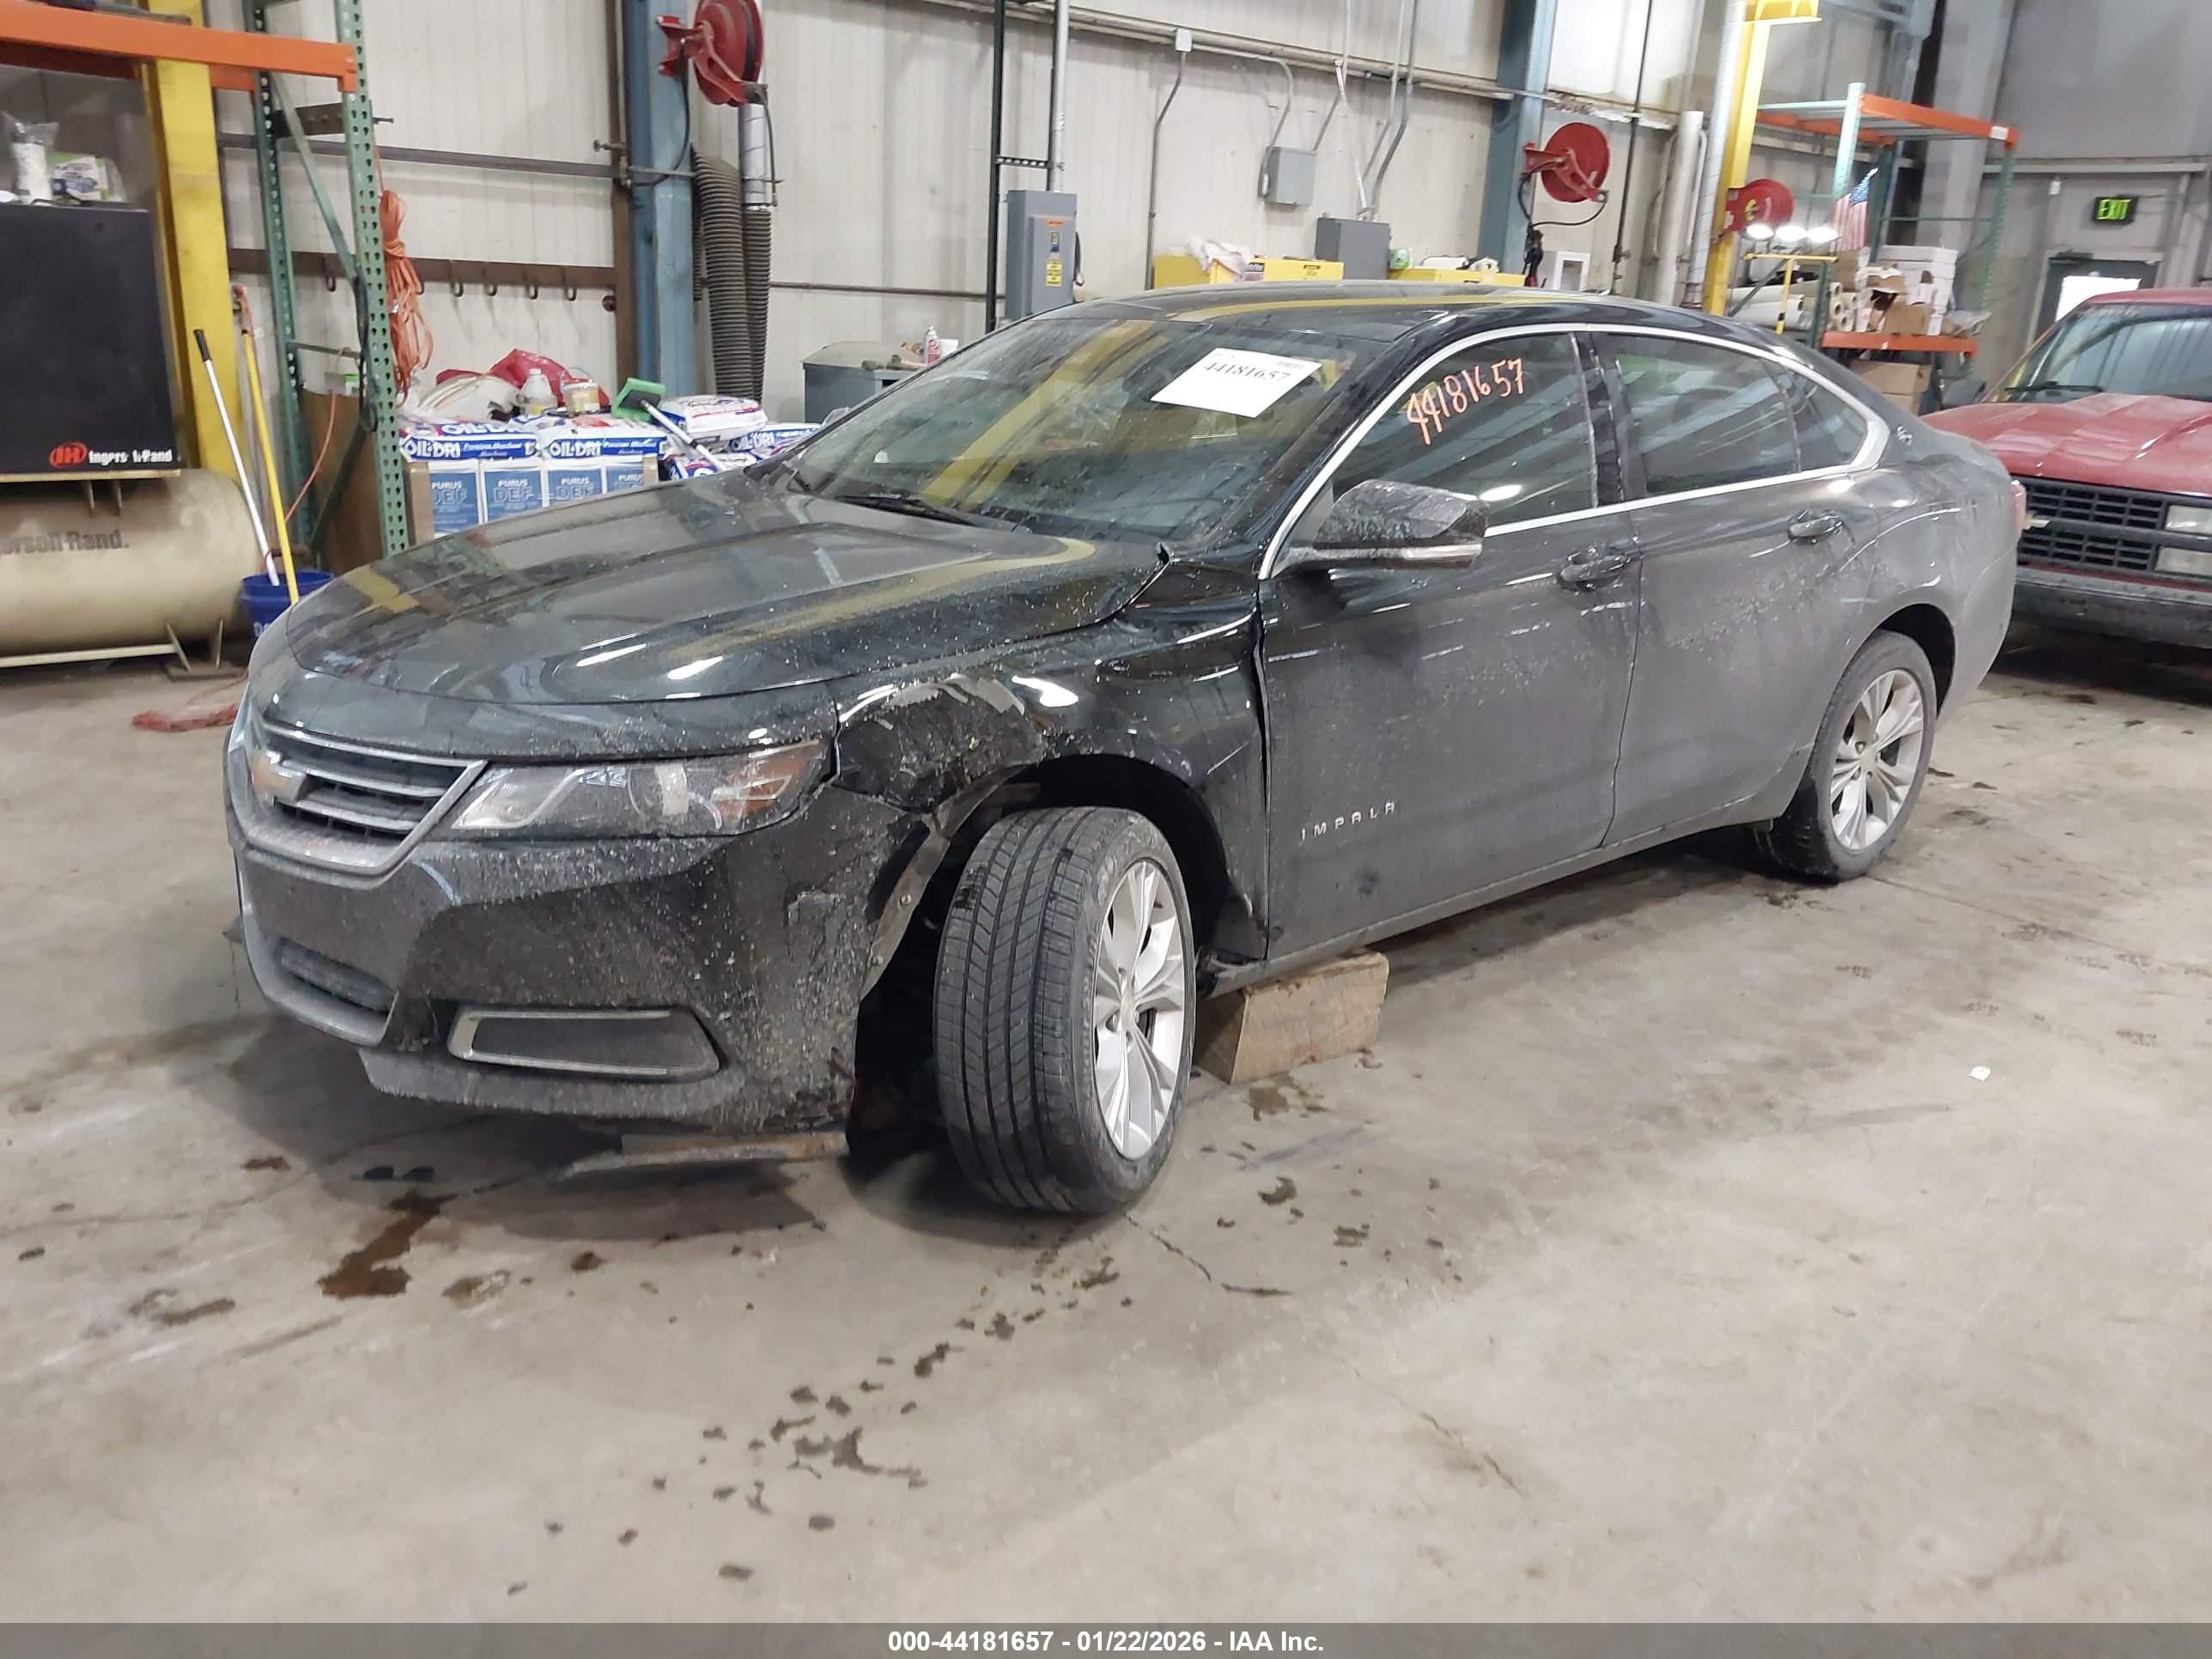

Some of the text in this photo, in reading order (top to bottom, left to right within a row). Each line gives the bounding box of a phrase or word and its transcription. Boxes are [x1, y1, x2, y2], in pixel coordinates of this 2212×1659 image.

[2096, 198, 2132, 221] EXIT
[1203, 362, 1292, 384] 44181657
[1407, 357, 1524, 446] 44181657
[1301, 799, 1395, 841] IMPALA
